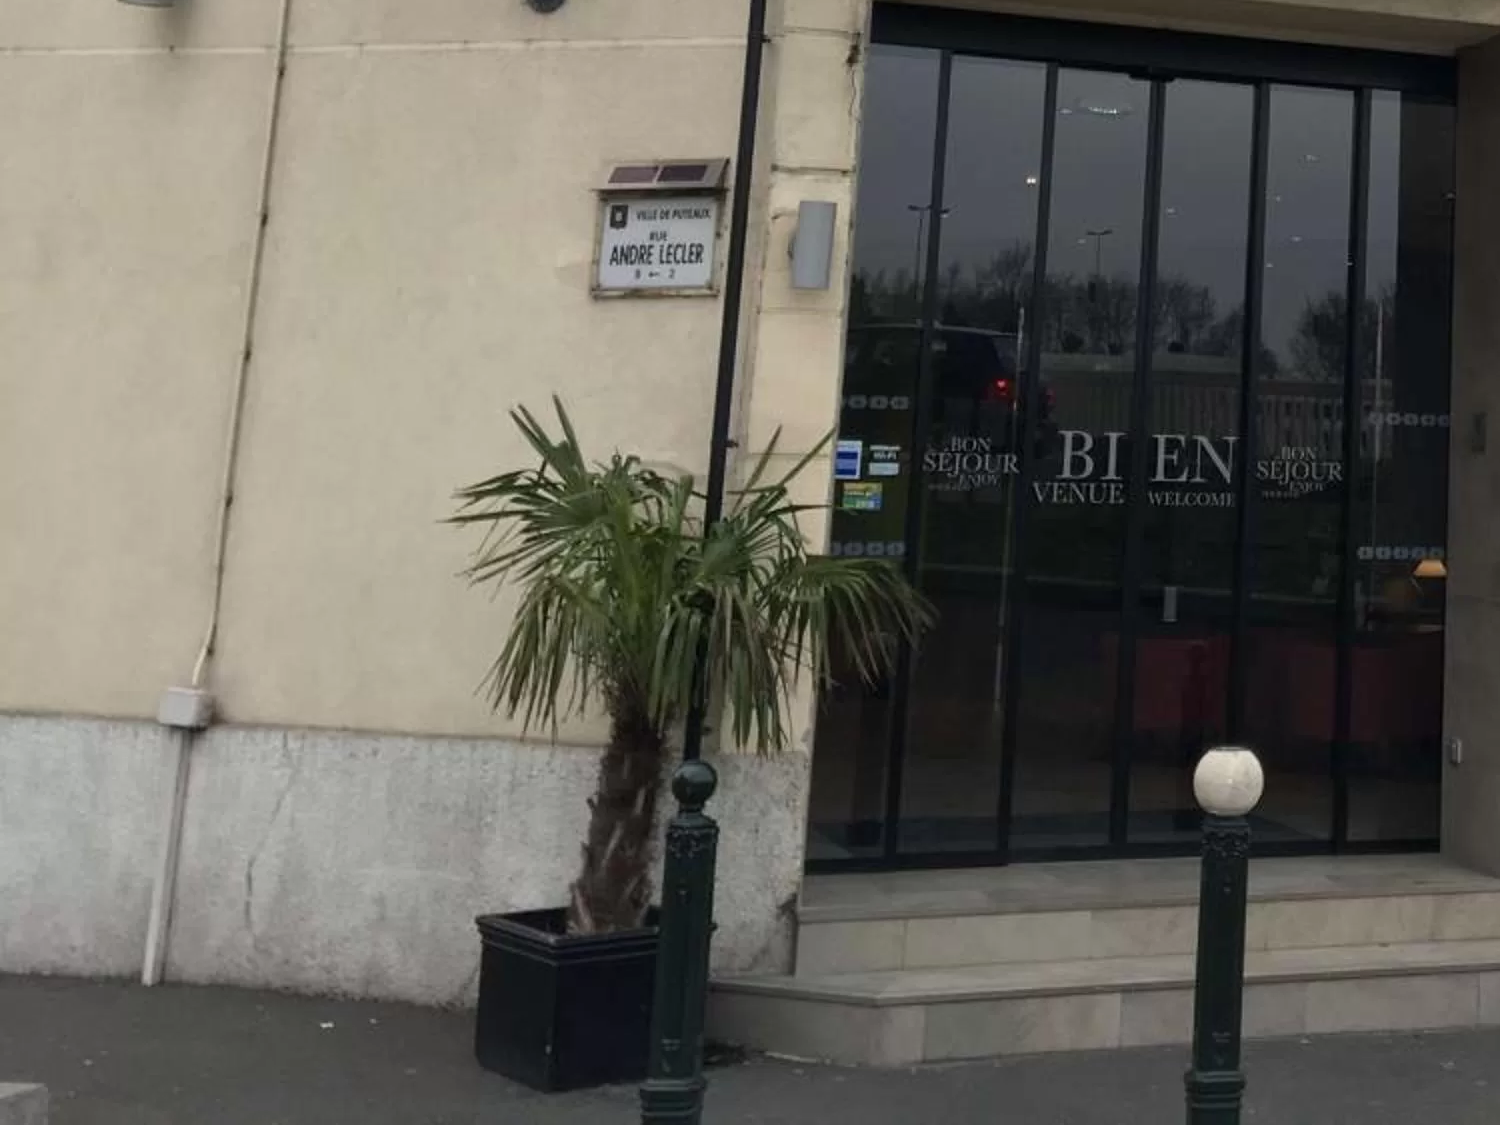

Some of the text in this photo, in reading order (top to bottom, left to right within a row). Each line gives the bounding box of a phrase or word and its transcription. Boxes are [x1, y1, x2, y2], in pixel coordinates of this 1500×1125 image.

[649, 231, 668, 242] RUE
[659, 243, 704, 264] LECLER
[951, 435, 993, 452] BON
[1281, 446, 1318, 460] BON
[922, 446, 1020, 478] SÉJOUR
[1033, 481, 1125, 505] VENUE
[1149, 491, 1236, 508] WELCOME
